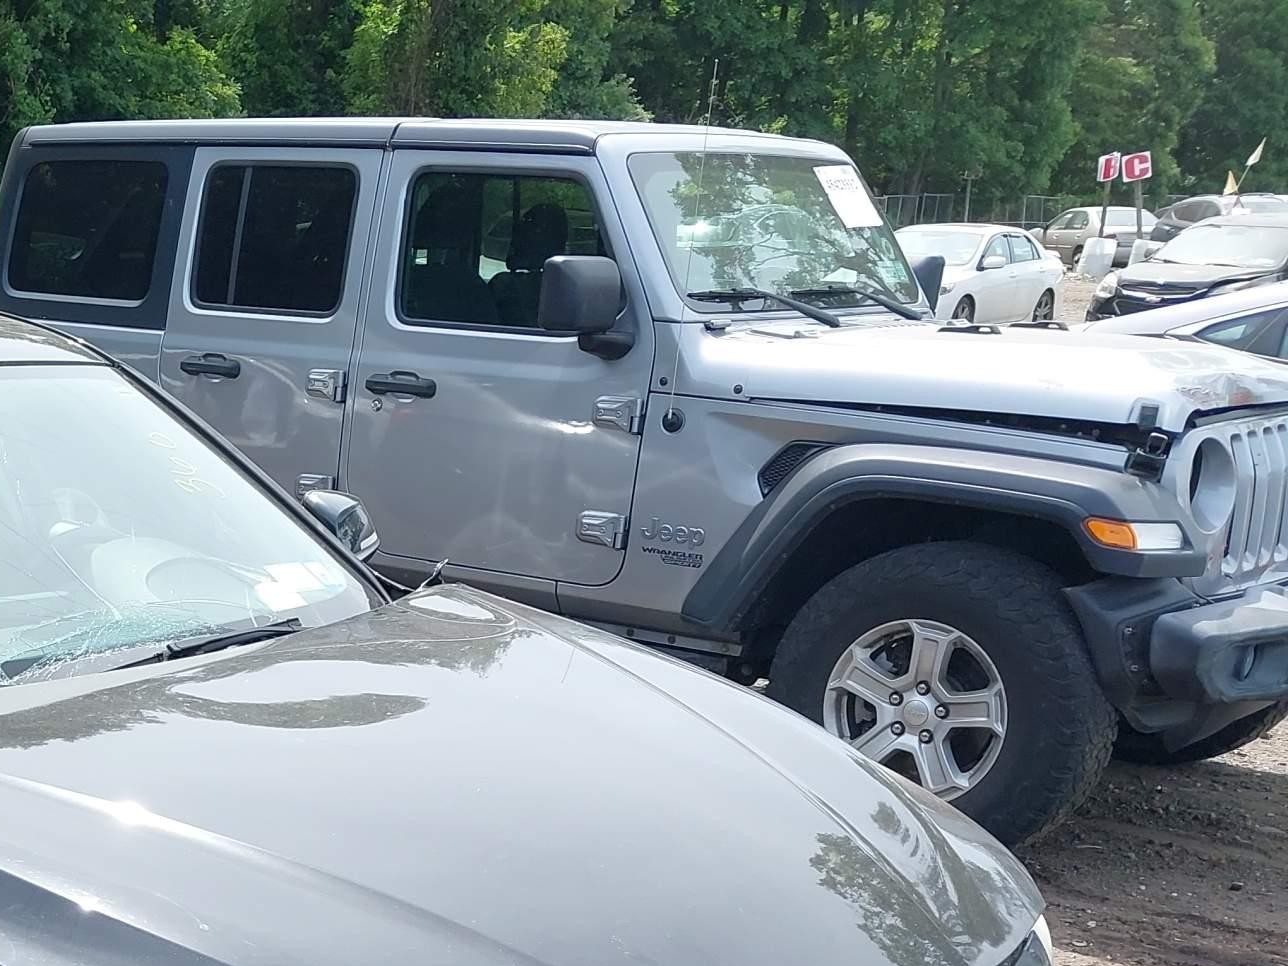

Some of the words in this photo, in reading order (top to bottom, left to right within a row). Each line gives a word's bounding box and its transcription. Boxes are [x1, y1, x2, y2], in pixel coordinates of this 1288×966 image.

[1125, 154, 1150, 179] C
[641, 517, 706, 549] Jeep
[641, 546, 704, 560] WRANGLER
